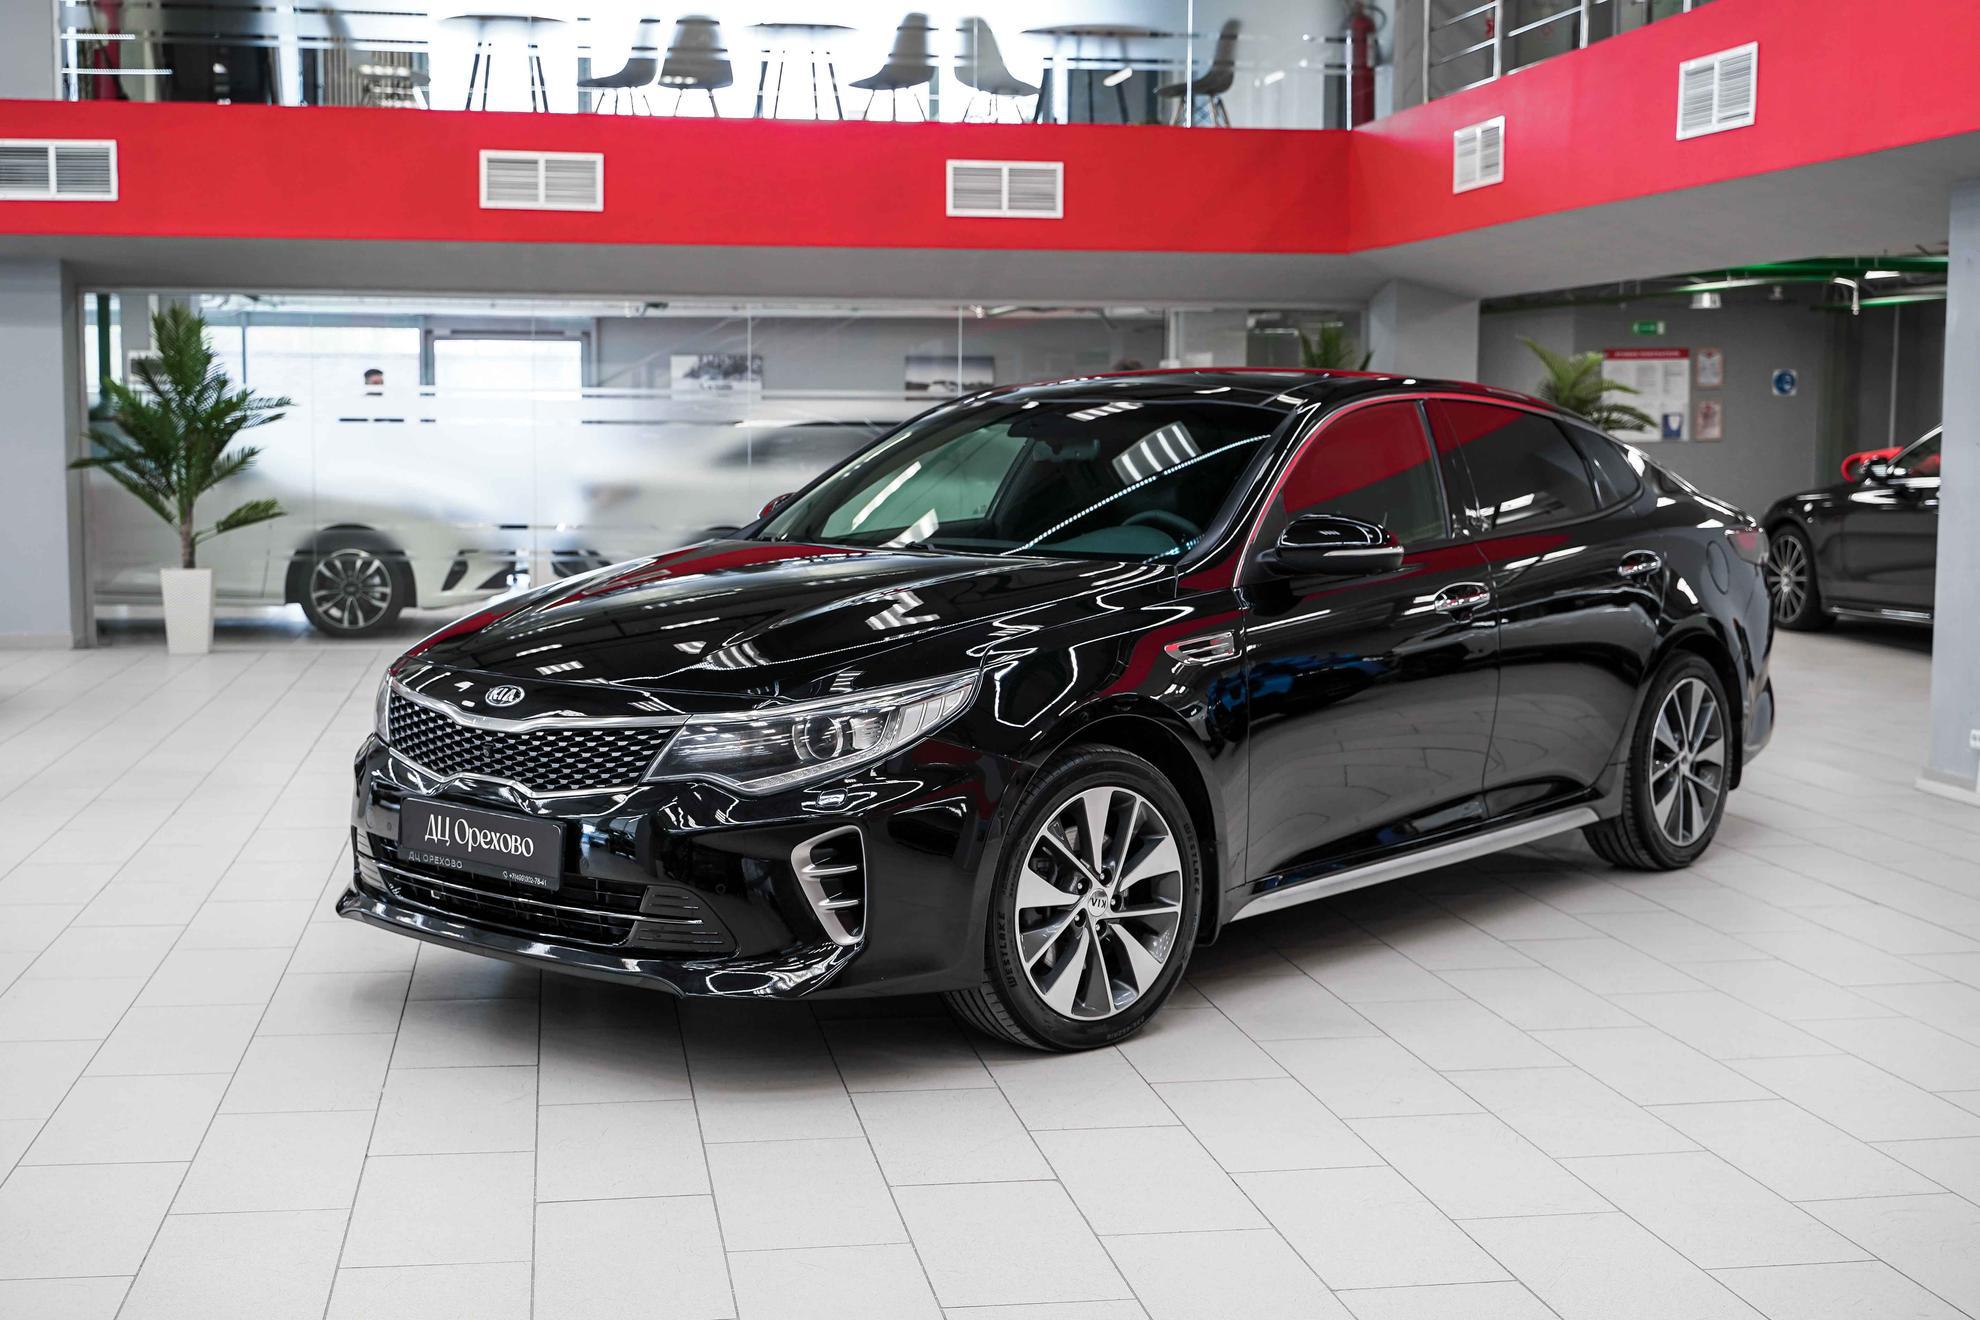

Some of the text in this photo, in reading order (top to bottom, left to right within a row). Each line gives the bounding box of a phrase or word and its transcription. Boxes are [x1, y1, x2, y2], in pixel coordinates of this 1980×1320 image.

[488, 687, 518, 703] KIA
[424, 814, 534, 857] ДЦ Орехово
[408, 851, 463, 869] ДЦ ОРЕХОВО
[1091, 897, 1107, 909] KIA
[997, 911, 1018, 988] WESTLAKE
